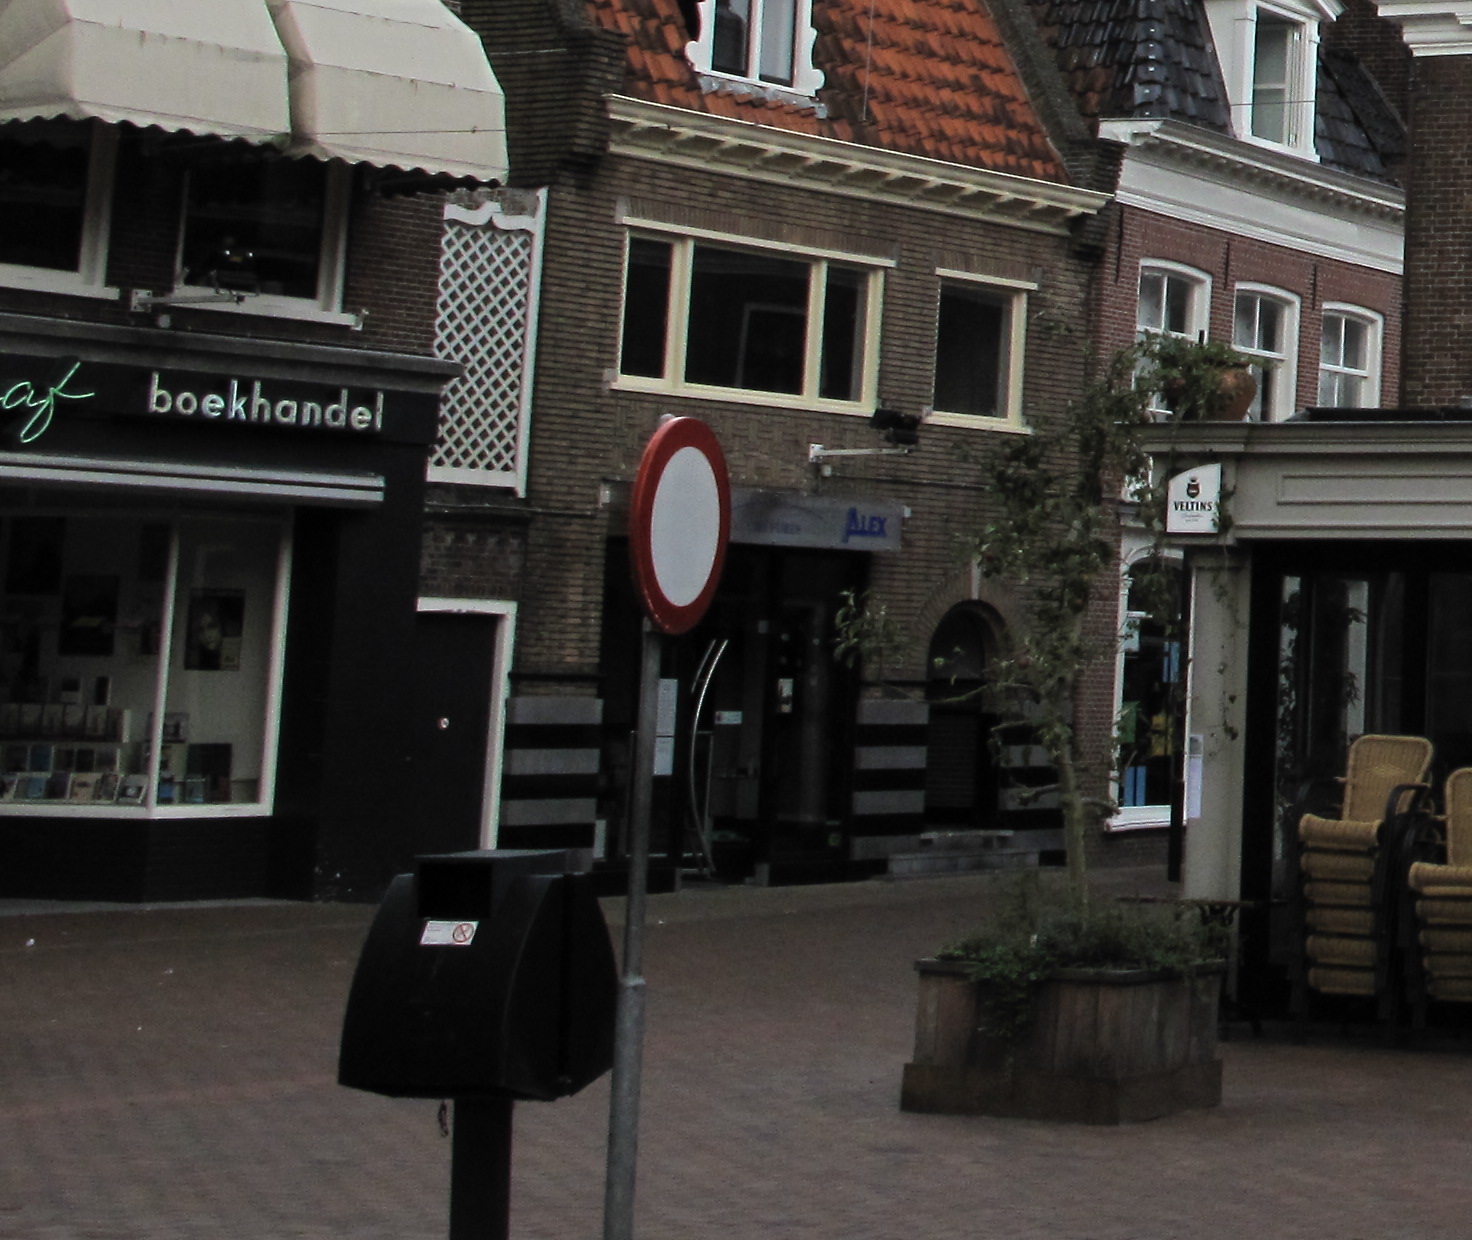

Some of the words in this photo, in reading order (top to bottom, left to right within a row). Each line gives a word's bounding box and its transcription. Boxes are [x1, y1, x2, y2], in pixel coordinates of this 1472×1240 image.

[0, 361, 95, 443] af
[150, 370, 385, 433] boekhandel
[1174, 501, 1213, 512] VELTINS
